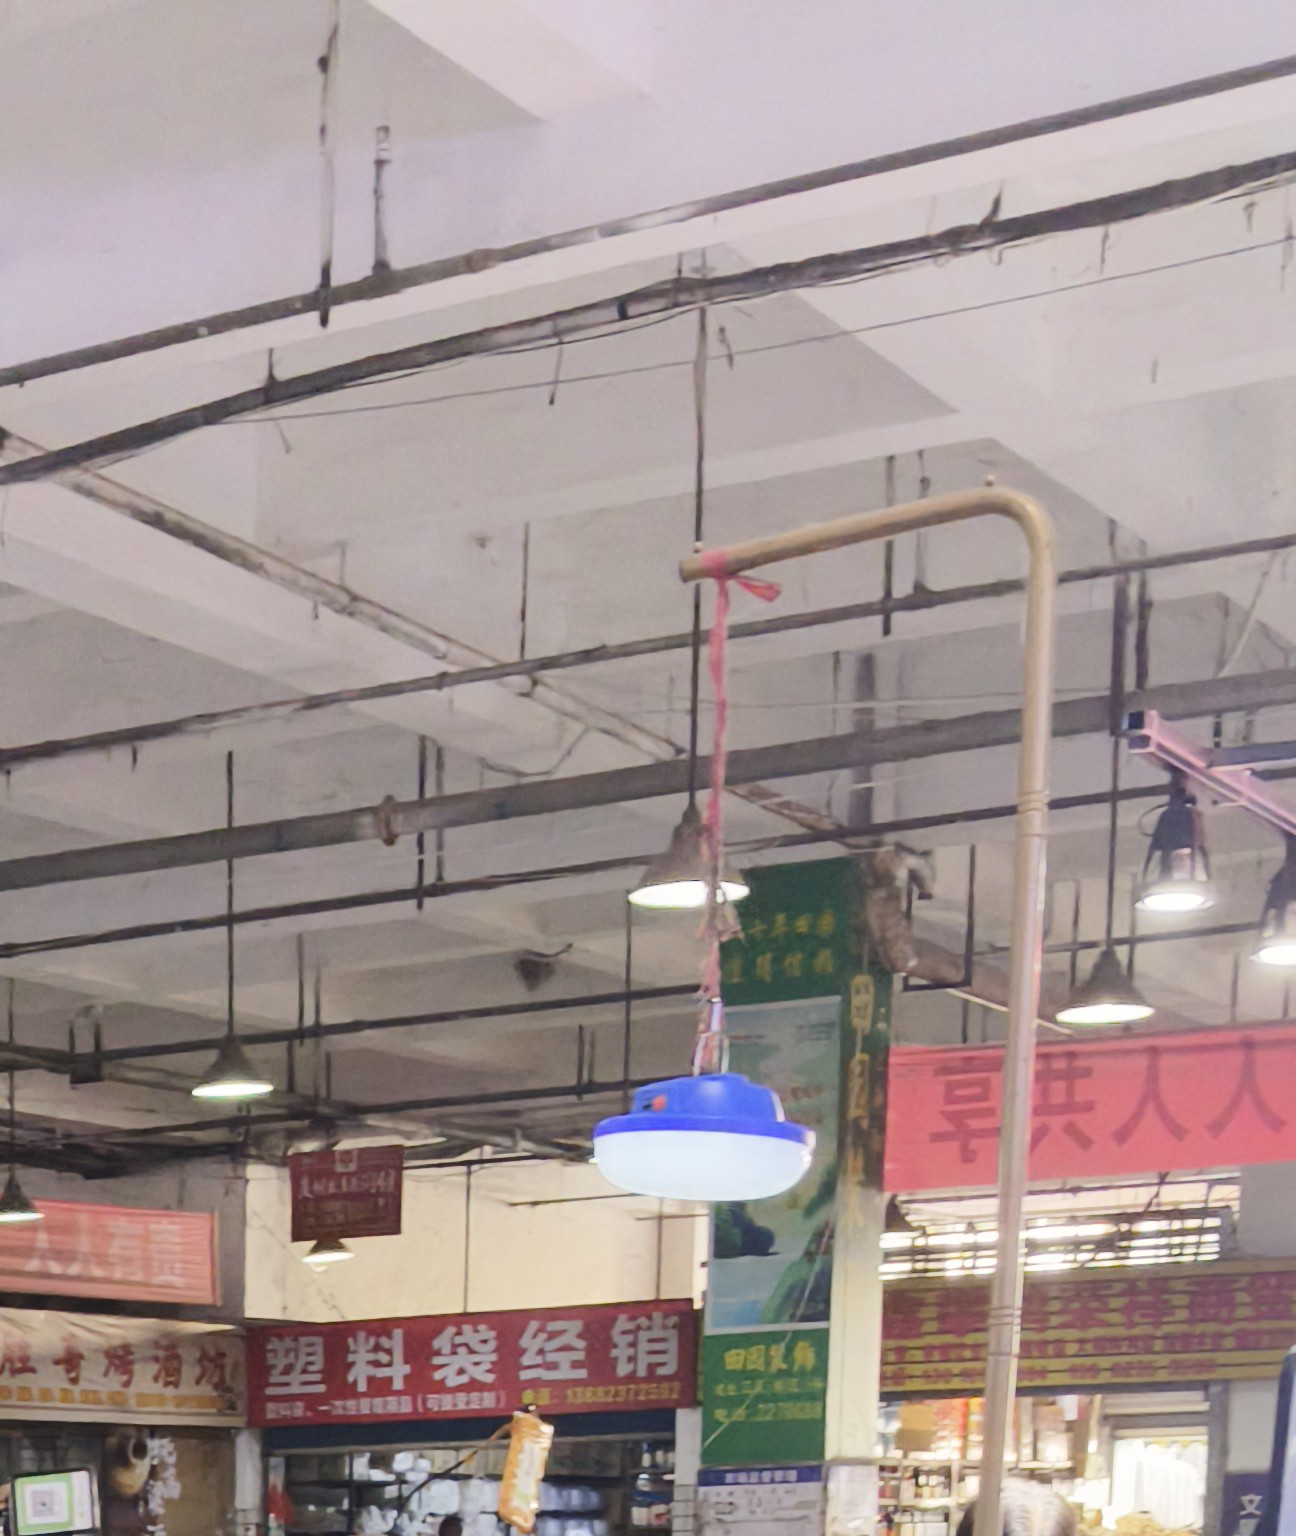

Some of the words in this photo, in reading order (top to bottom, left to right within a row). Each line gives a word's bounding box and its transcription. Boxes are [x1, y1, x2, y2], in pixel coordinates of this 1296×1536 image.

[263, 1312, 681, 1396] 塑料袋经销
